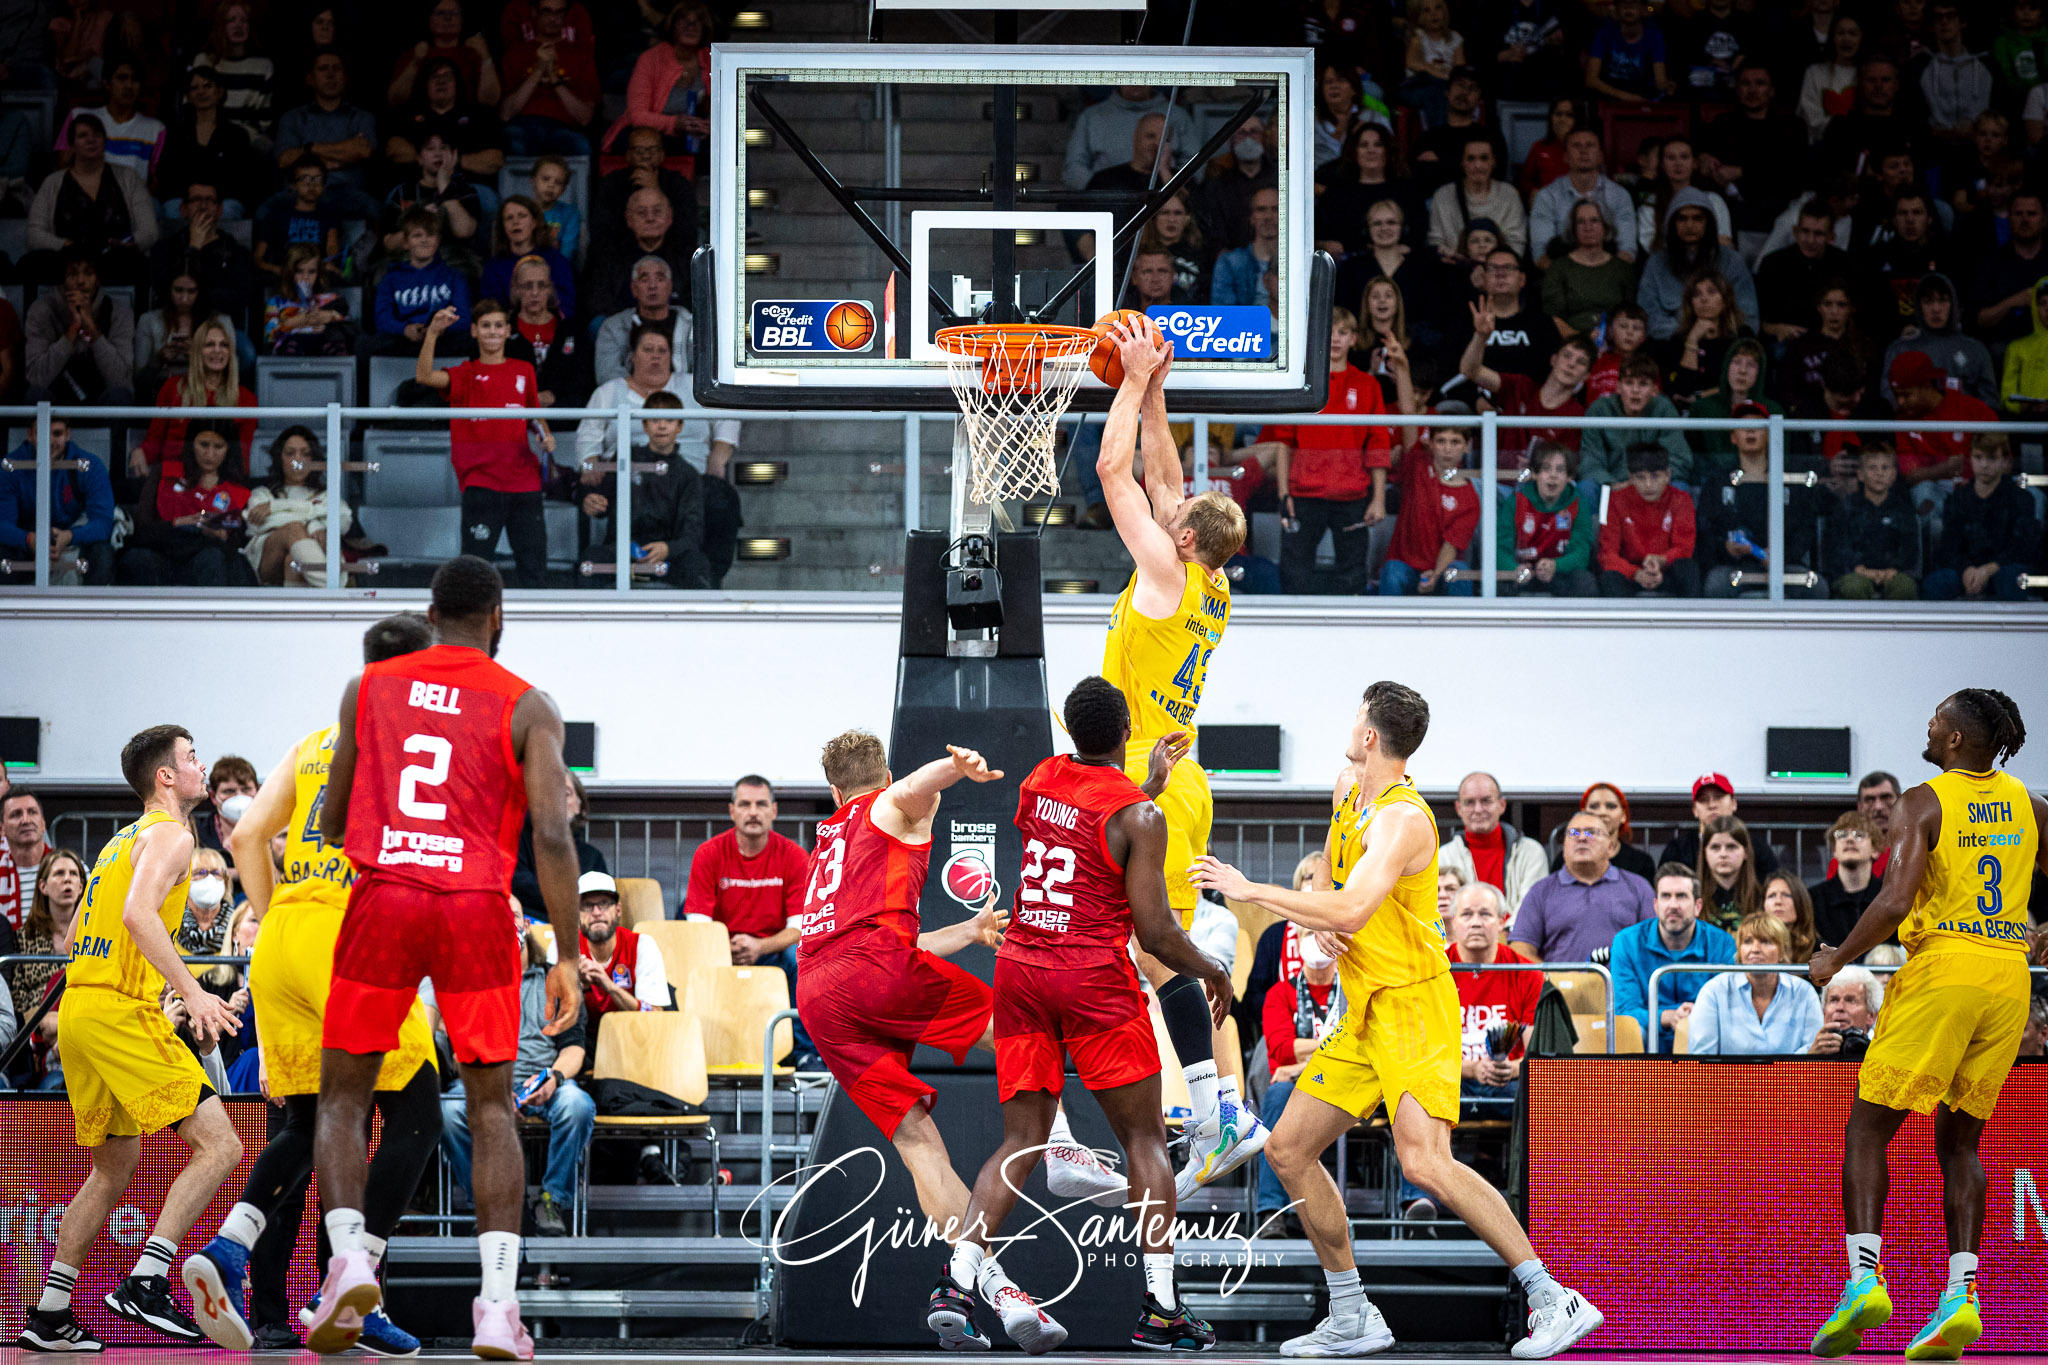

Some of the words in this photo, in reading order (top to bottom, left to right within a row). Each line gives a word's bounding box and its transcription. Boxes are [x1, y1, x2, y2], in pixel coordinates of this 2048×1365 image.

[776, 315, 813, 325] Credit
[761, 326, 813, 347] BBL
[1186, 332, 1263, 352] Credit
[1485, 330, 1530, 346] ASA
[408, 681, 461, 715] BELL
[398, 733, 453, 820] 2
[1035, 795, 1079, 829] YOUNG
[1968, 801, 2012, 823] SMITH
[951, 820, 996, 833] brose
[951, 833, 995, 843] bamberg
[382, 825, 464, 854] brose
[377, 849, 463, 873] bamberg
[1021, 838, 1076, 906] 22
[1977, 855, 2002, 916] 3
